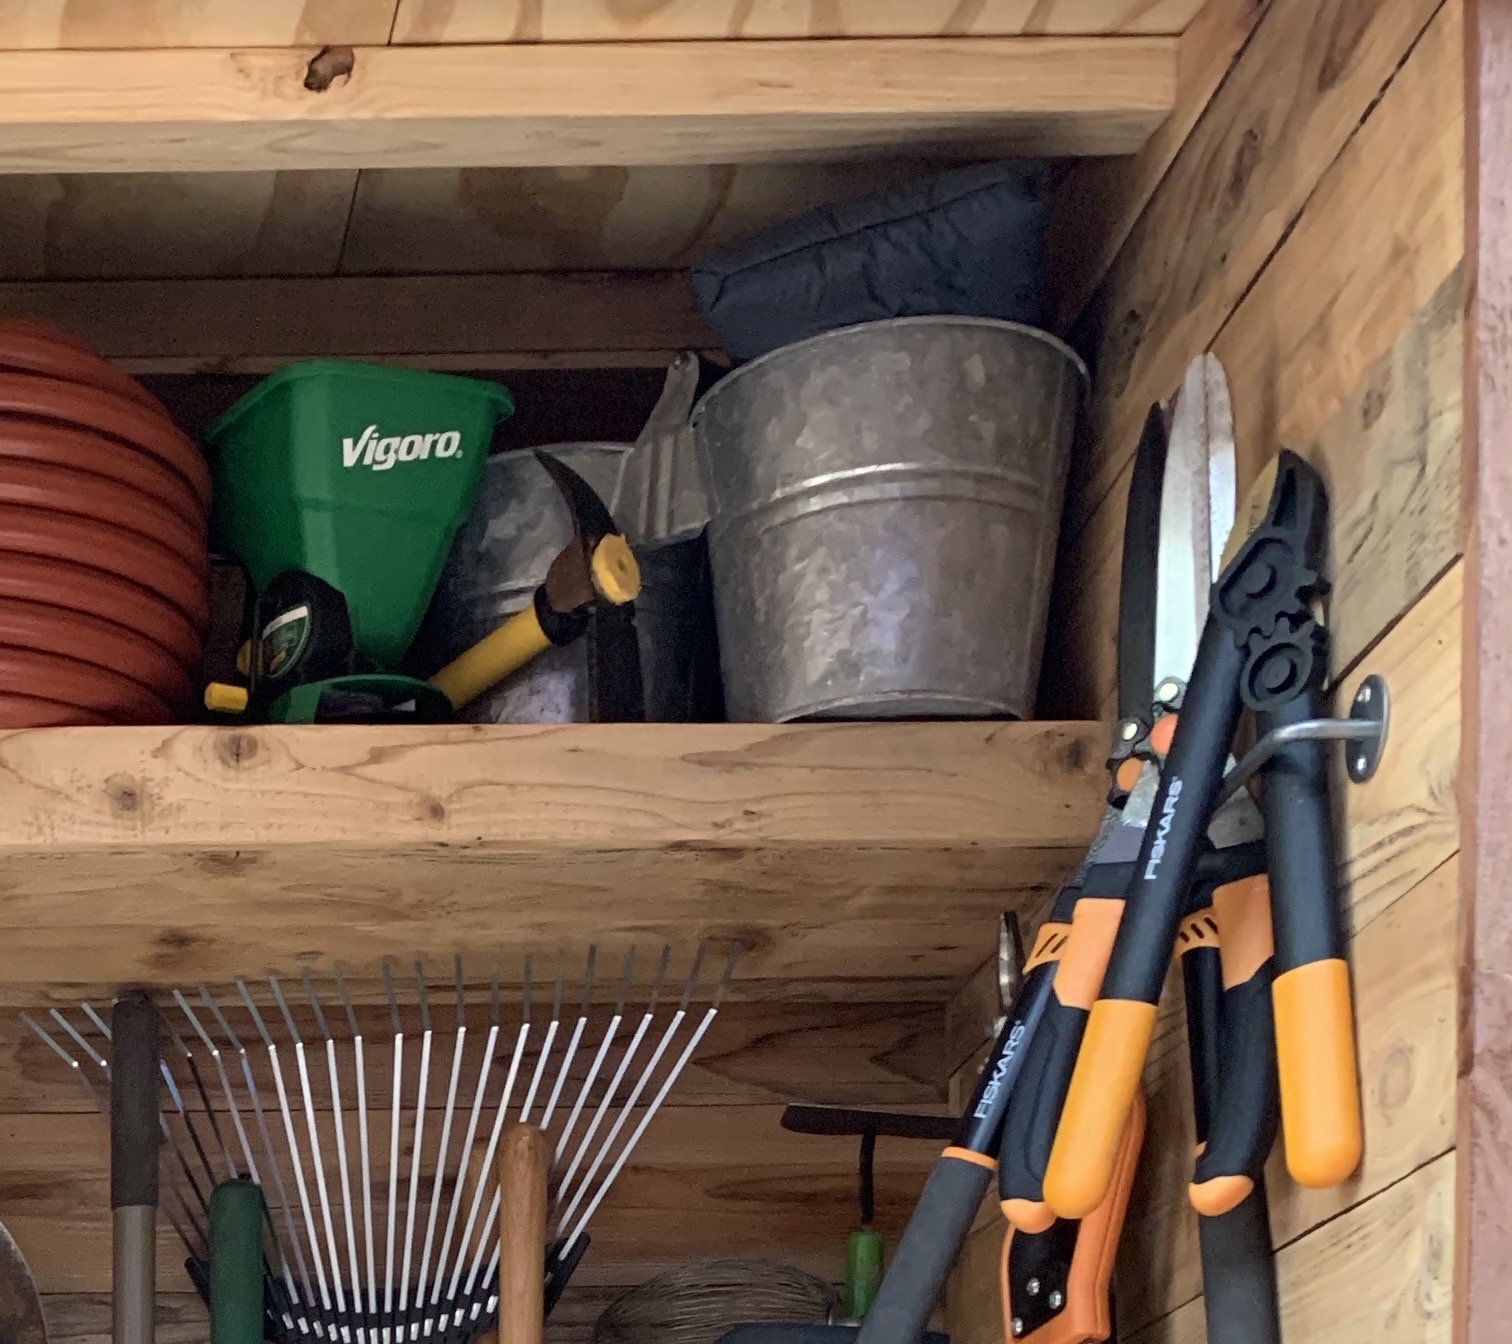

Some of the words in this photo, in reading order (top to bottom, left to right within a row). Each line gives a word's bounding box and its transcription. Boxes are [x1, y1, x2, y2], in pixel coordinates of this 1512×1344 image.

[342, 424, 461, 471] Vigoro
[1144, 779, 1183, 880] FISKARS
[973, 1025, 1025, 1119] FISKARS
